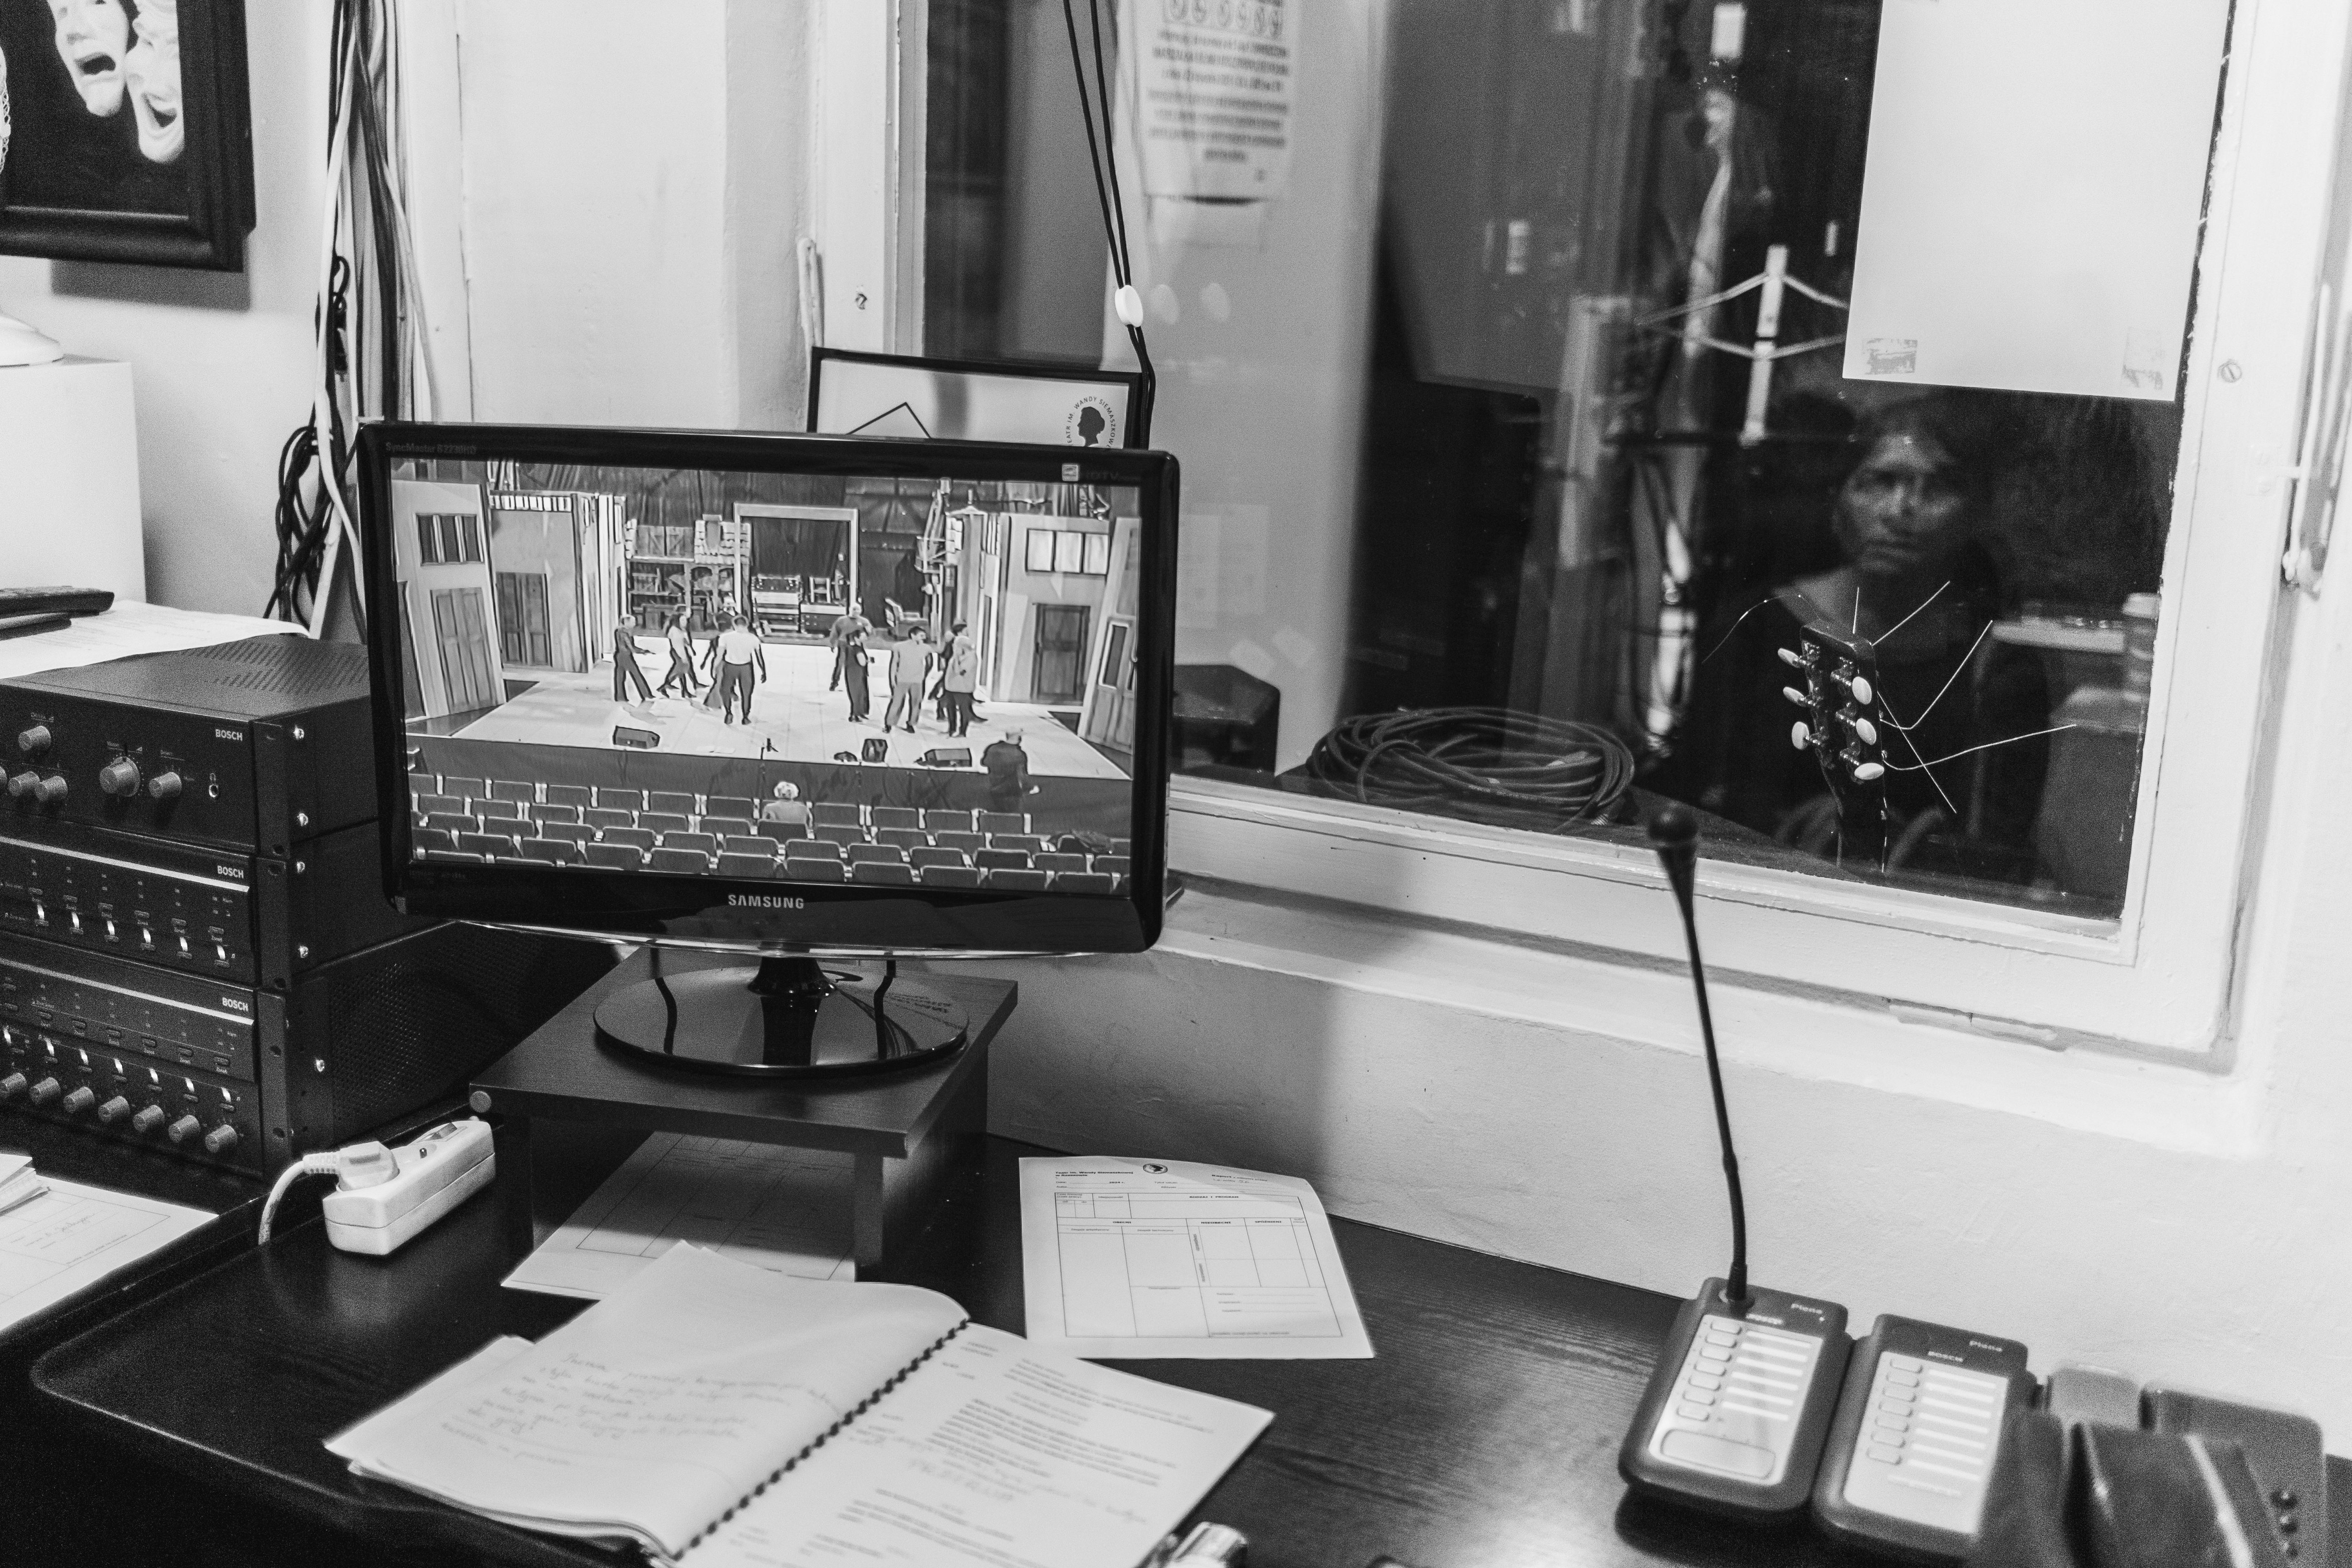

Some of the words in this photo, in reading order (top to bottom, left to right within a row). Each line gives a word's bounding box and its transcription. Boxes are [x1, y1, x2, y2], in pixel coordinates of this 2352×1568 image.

[1074, 396, 1097, 410] WANDY
[215, 729, 243, 742] BOSCH
[217, 865, 244, 879] BOSCH
[728, 894, 804, 909] SAMSUNG
[222, 997, 248, 1012] BOSCH
